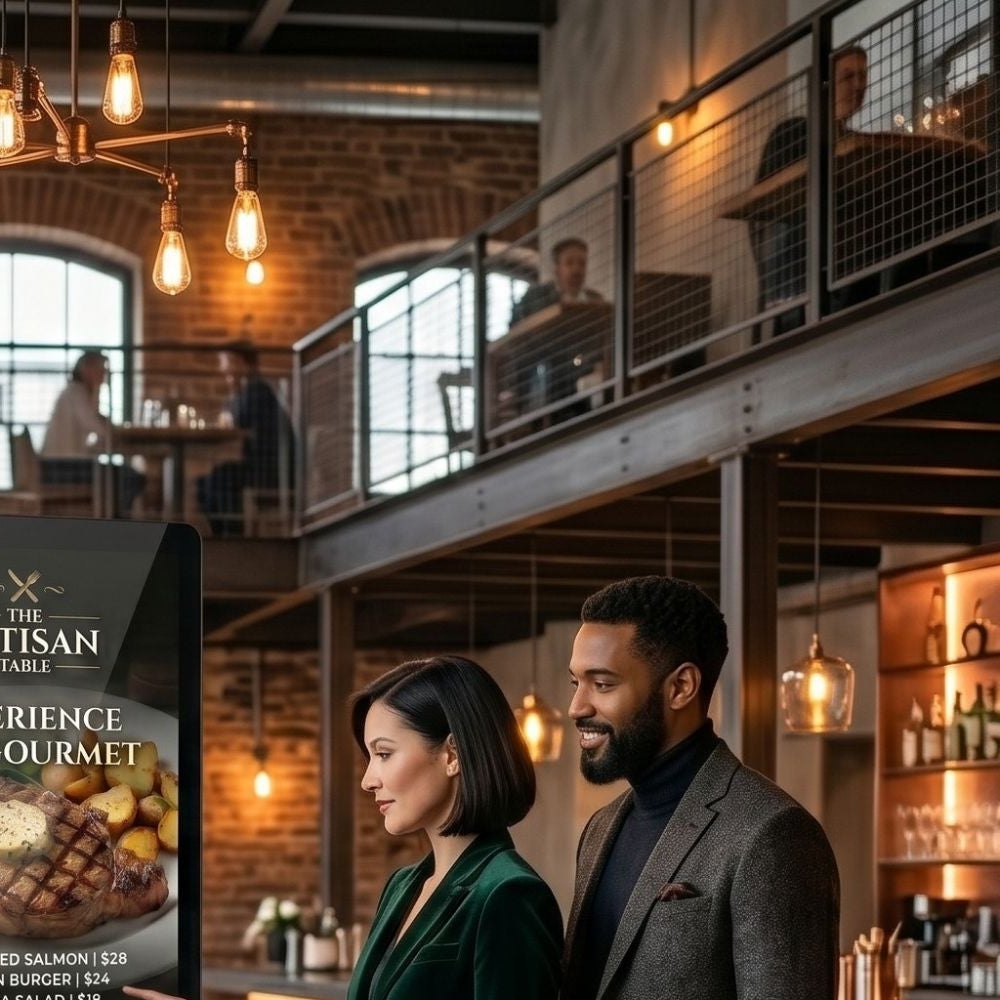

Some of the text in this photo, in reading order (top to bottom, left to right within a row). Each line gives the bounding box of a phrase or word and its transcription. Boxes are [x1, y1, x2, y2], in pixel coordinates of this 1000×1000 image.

[7, 608, 42, 623] THE
[0, 658, 51, 673] TABLE
[24, 952, 89, 966] SALMON
[101, 952, 127, 967] $28
[10, 973, 71, 986] BURGER
[84, 972, 110, 986] $24
